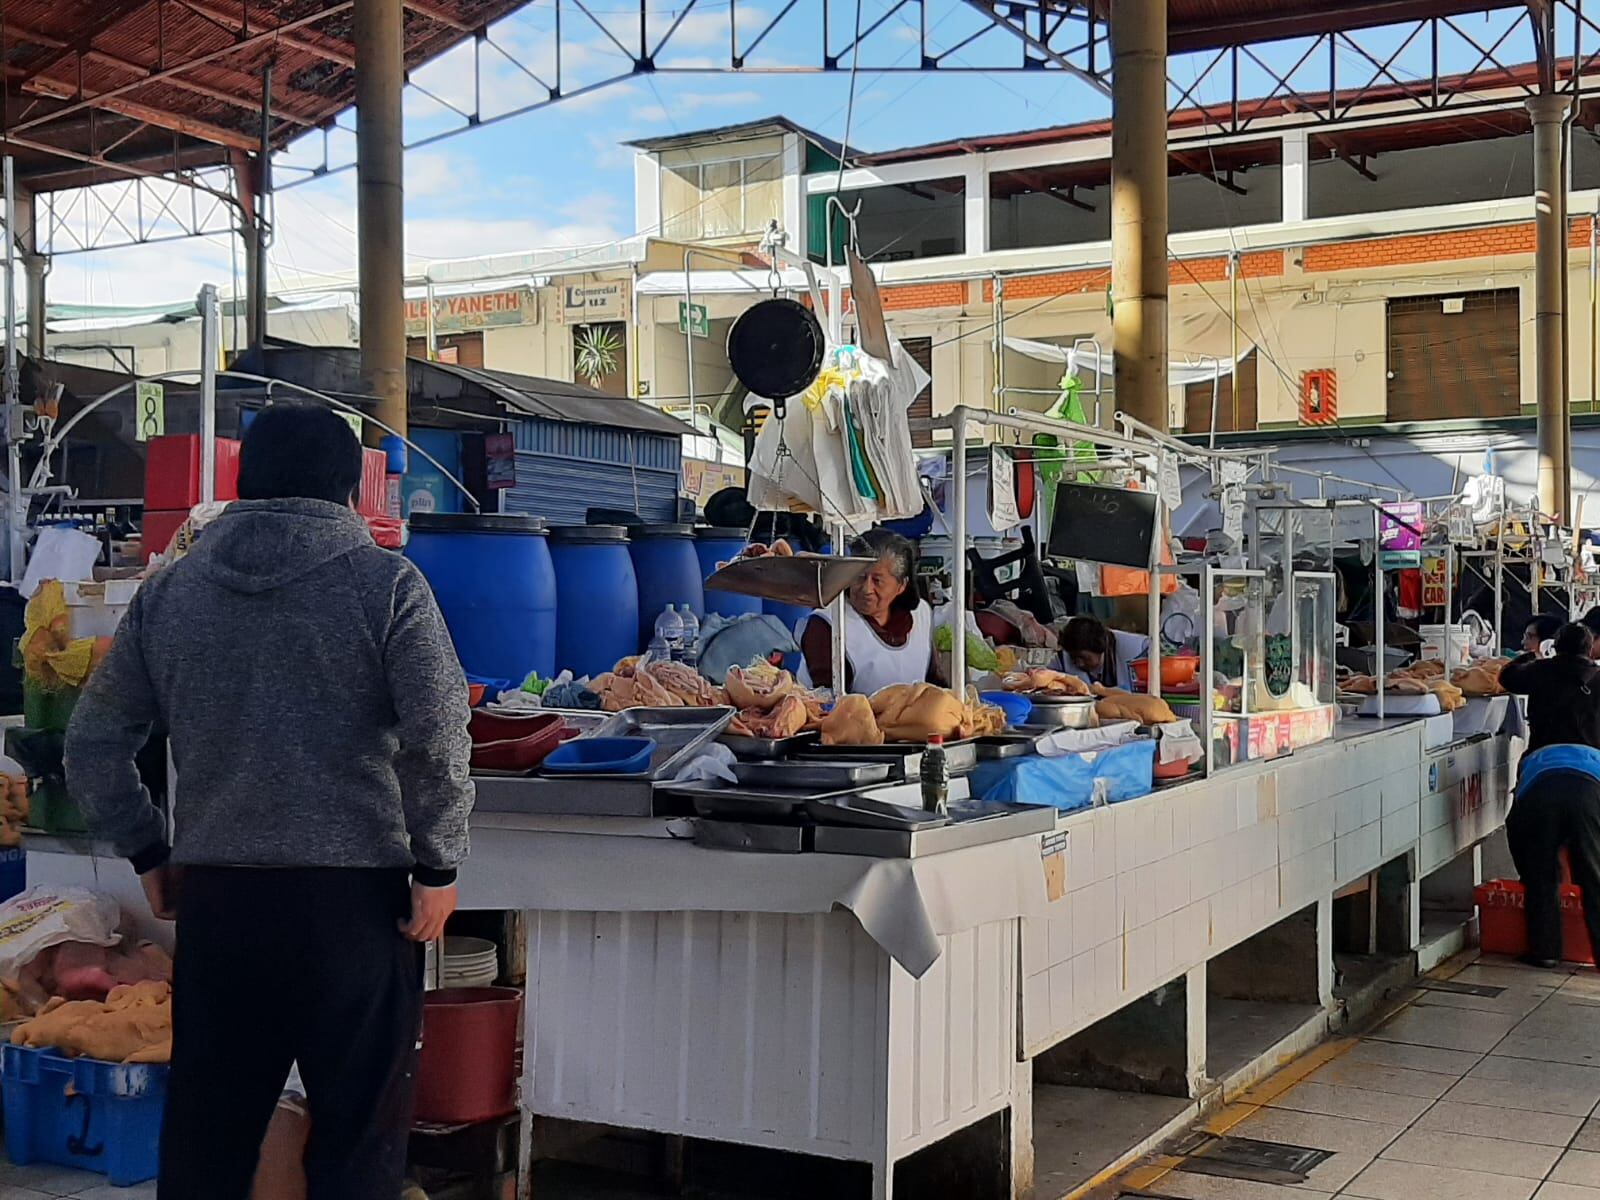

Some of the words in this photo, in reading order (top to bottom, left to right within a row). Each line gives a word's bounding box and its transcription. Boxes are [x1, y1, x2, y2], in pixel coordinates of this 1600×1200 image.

[447, 291, 518, 315] YANETH
[575, 286, 617, 297] Comercial
[142, 396, 158, 437] 8
